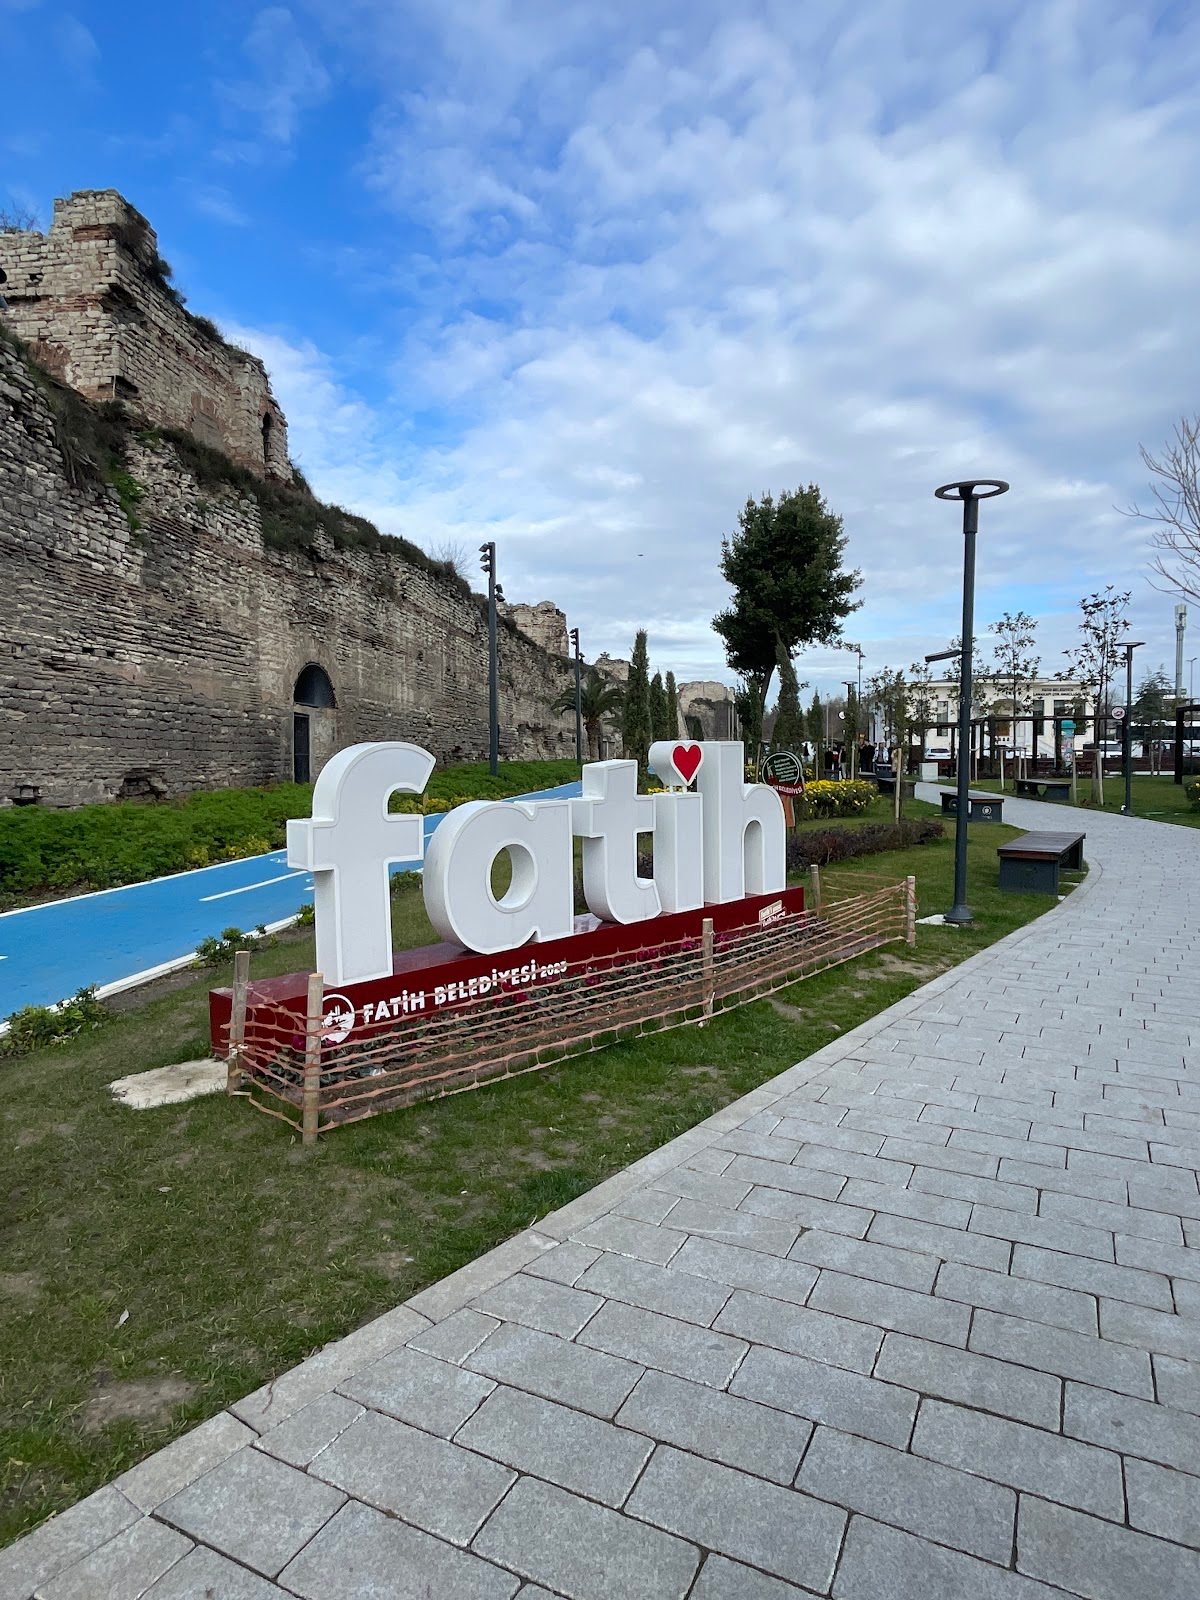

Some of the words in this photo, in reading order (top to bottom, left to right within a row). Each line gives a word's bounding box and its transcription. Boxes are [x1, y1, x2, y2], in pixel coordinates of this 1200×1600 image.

[286, 740, 787, 988] fatih
[363, 989, 426, 1023] FATİH
[434, 959, 537, 1005] BELEDİYESİ
